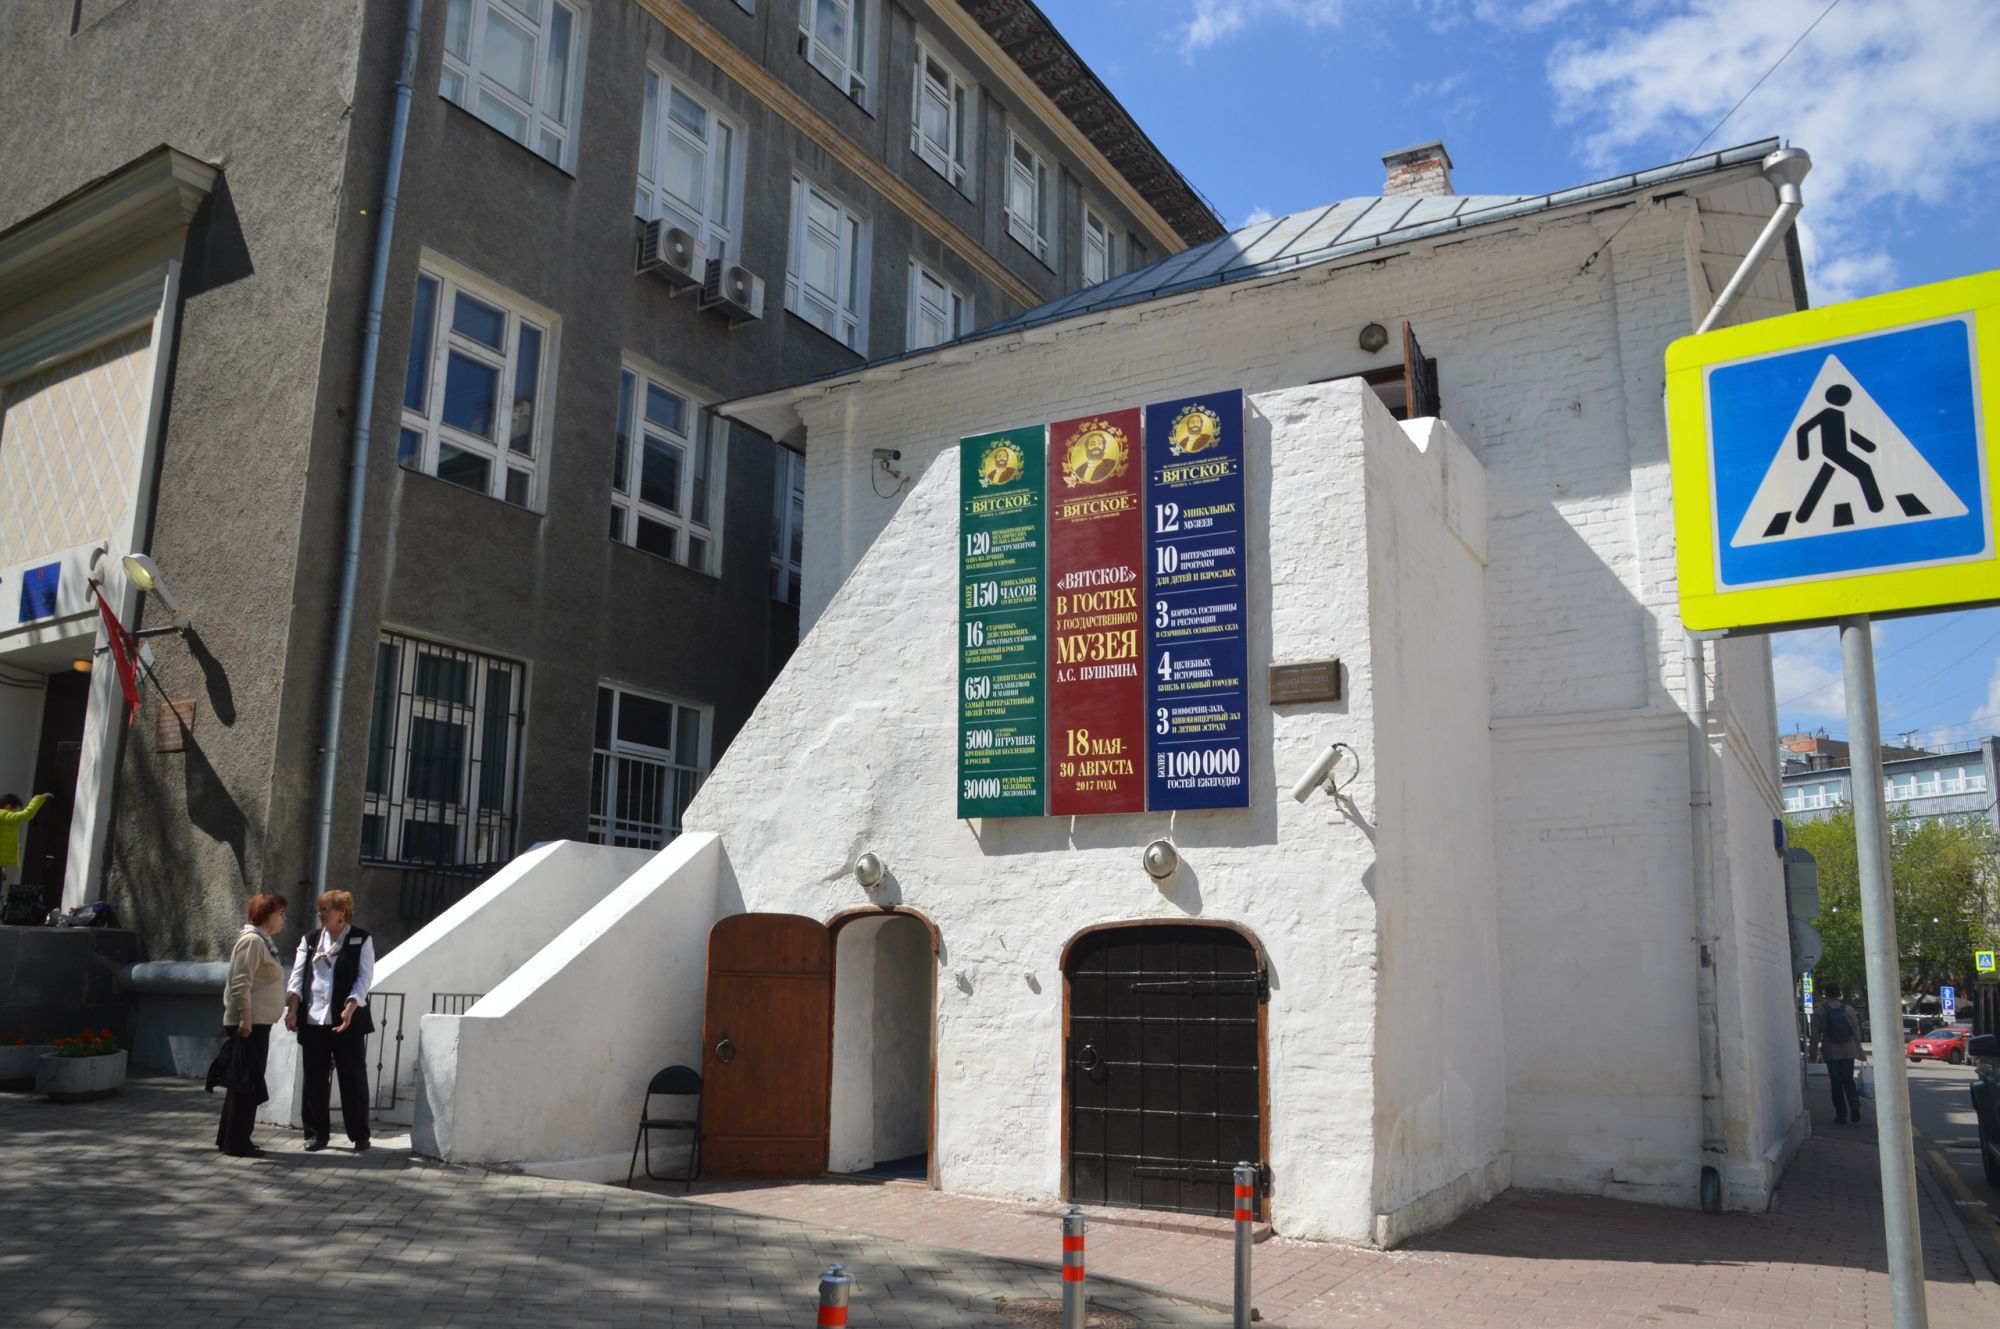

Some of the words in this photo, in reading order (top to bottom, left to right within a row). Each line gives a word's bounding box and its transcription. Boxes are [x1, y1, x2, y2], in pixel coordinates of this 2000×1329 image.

[1163, 462, 1229, 483] ВЯТСКОЕ
[973, 494, 1031, 512] ВЯТСКОЕ
[1064, 497, 1129, 517] ВЯТСКОЕ
[1183, 503, 1236, 518] УНИКАЛЬНЫХ
[1155, 502, 1179, 533] 12
[1184, 518, 1213, 529] МУЗЕЕВ
[966, 531, 990, 556] 120
[991, 541, 1036, 553] ИНСТРУМЕНТОВ
[1180, 546, 1236, 560] ИНТЕРАКТИВНЫХ
[1156, 545, 1178, 575] 10
[1180, 559, 1215, 570] ПРОГРАММ
[1001, 577, 1037, 587] УНИКАЛЬНЫХ
[1057, 566, 1137, 590] «ВЯТСКОЕ»
[1155, 577, 1169, 587] ДЛЯ
[1170, 572, 1192, 585] ДЕТЕЙ
[1193, 573, 1199, 581] И
[1200, 568, 1236, 580] ВЗРОСЛЫХ
[972, 581, 998, 608] 150
[1000, 584, 1037, 599] ЧАСОВ
[1056, 596, 1067, 615] В
[1072, 587, 1137, 613] ГОСТЯХ
[1155, 600, 1169, 628] 3
[1170, 608, 1198, 617] КОРПУСА
[1198, 602, 1237, 615] ГОСТИНИЦЫ
[1056, 620, 1062, 631] У
[1063, 612, 1138, 630] ГОСУДАРСТВЕННОГО
[1160, 628, 1192, 638] СТАРИННЫХ
[1225, 623, 1239, 631] СЕЛА
[1171, 618, 1176, 627] И
[965, 621, 983, 647] 16
[1056, 629, 1138, 664] МУЗЕЯ
[1057, 668, 1076, 682] А.С.
[1080, 663, 1137, 680] ПУШКИНА
[1157, 651, 1172, 681] 4
[1173, 658, 1211, 670] ЦЕЛЕБНЫХ
[1174, 669, 1214, 680] ИСТОЧНИКА
[1212, 677, 1239, 688] ГОРОДОК
[965, 675, 990, 700] 650
[1156, 707, 1169, 735] 3
[966, 729, 993, 749] 5000
[995, 735, 1036, 747] ИГРУШЕК
[1066, 729, 1090, 756] 18
[1060, 762, 1075, 777] 30
[1078, 759, 1134, 776] АВГУСТА
[1157, 752, 1166, 778] БОЛЕЕ
[1076, 780, 1095, 791] 2017
[1096, 780, 1117, 791] ГОДА
[1168, 777, 1196, 789] ГОСТЕЙ
[1197, 775, 1241, 788] ЕЖЕГОДНО
